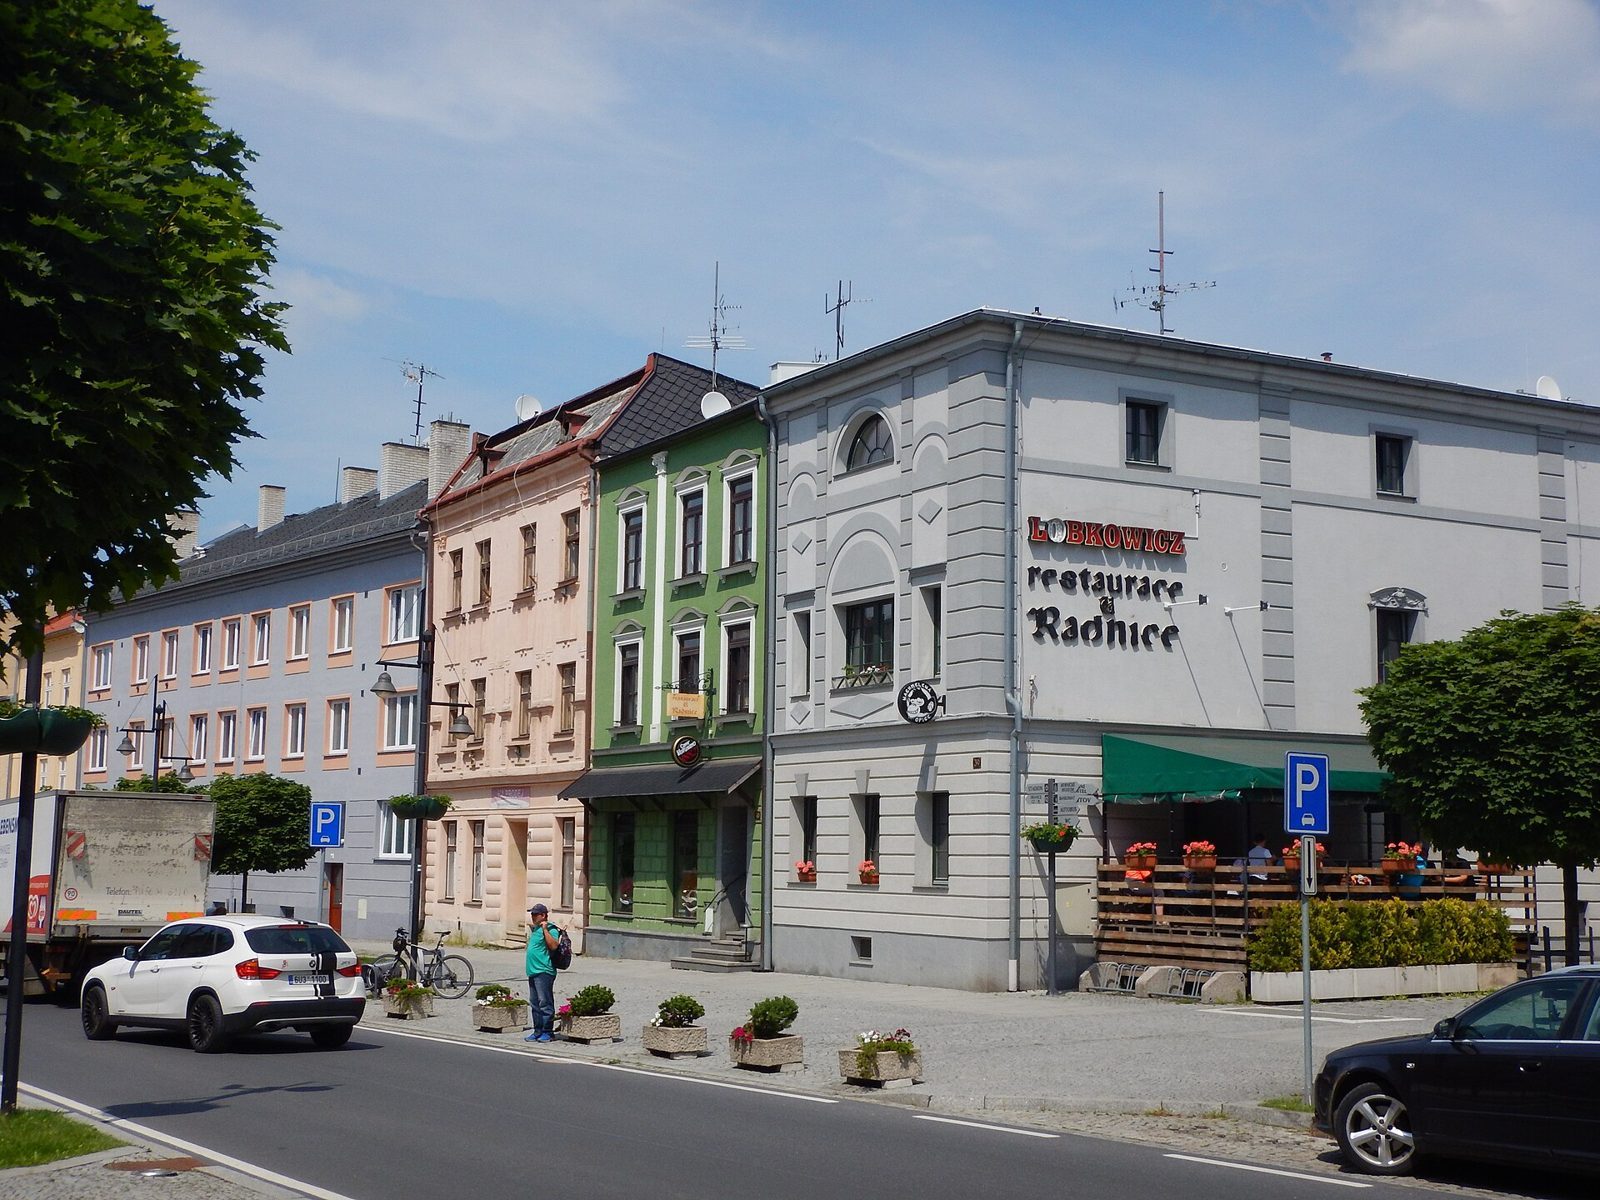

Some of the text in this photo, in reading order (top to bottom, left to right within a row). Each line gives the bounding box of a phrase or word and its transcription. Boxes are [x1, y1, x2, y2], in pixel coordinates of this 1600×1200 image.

[1027, 516, 1186, 555] LOBKOWICZ
[1027, 565, 1183, 600] restaurace
[1026, 606, 1179, 647] Radnice
[1296, 763, 1320, 808] P
[0, 817, 18, 835] EBENS
[316, 808, 335, 834] P
